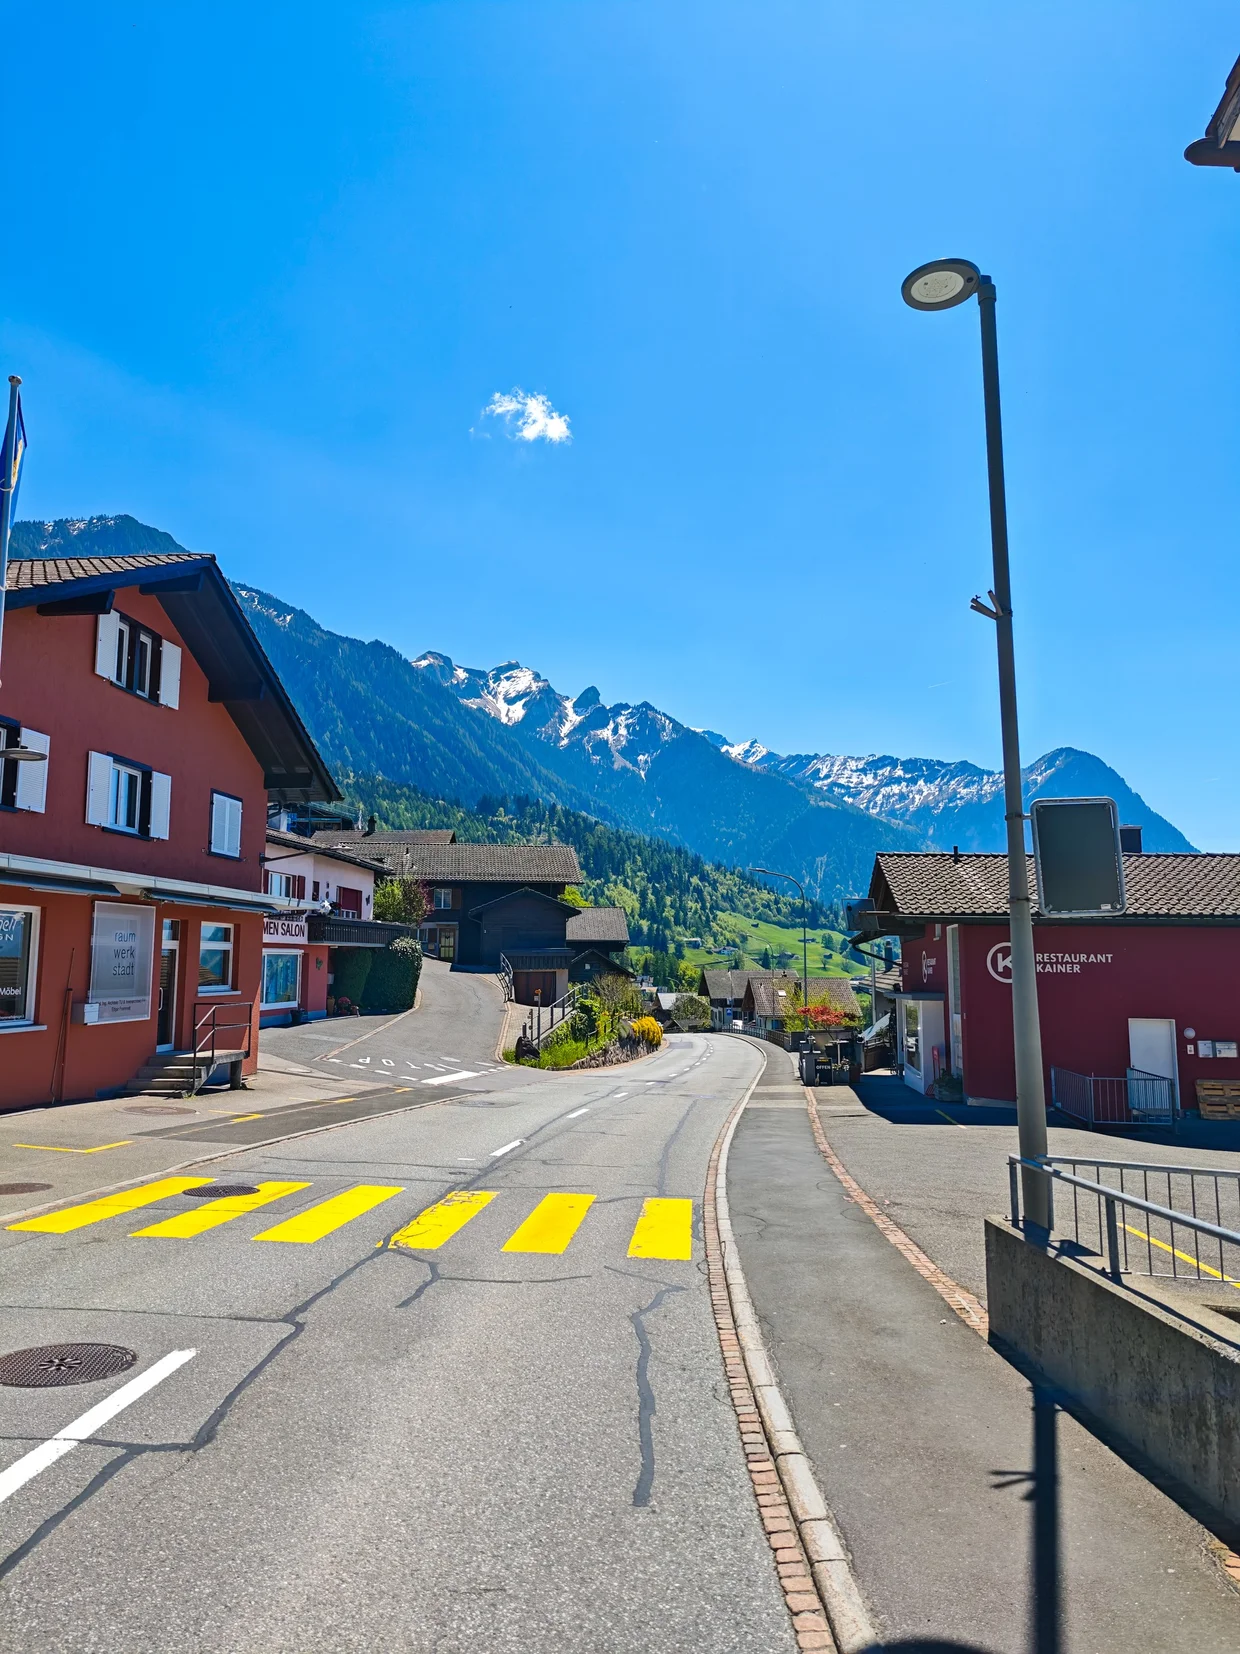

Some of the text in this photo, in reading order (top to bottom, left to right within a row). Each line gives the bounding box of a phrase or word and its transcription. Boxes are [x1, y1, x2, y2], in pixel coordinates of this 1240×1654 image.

[280, 922, 305, 937] SALON
[114, 932, 136, 942] raum
[113, 945, 135, 959] werk
[1036, 953, 1113, 963] RESTAURANT
[112, 962, 134, 976] stadt
[1036, 964, 1081, 973] KAINER
[358, 1056, 446, 1072] STOP
